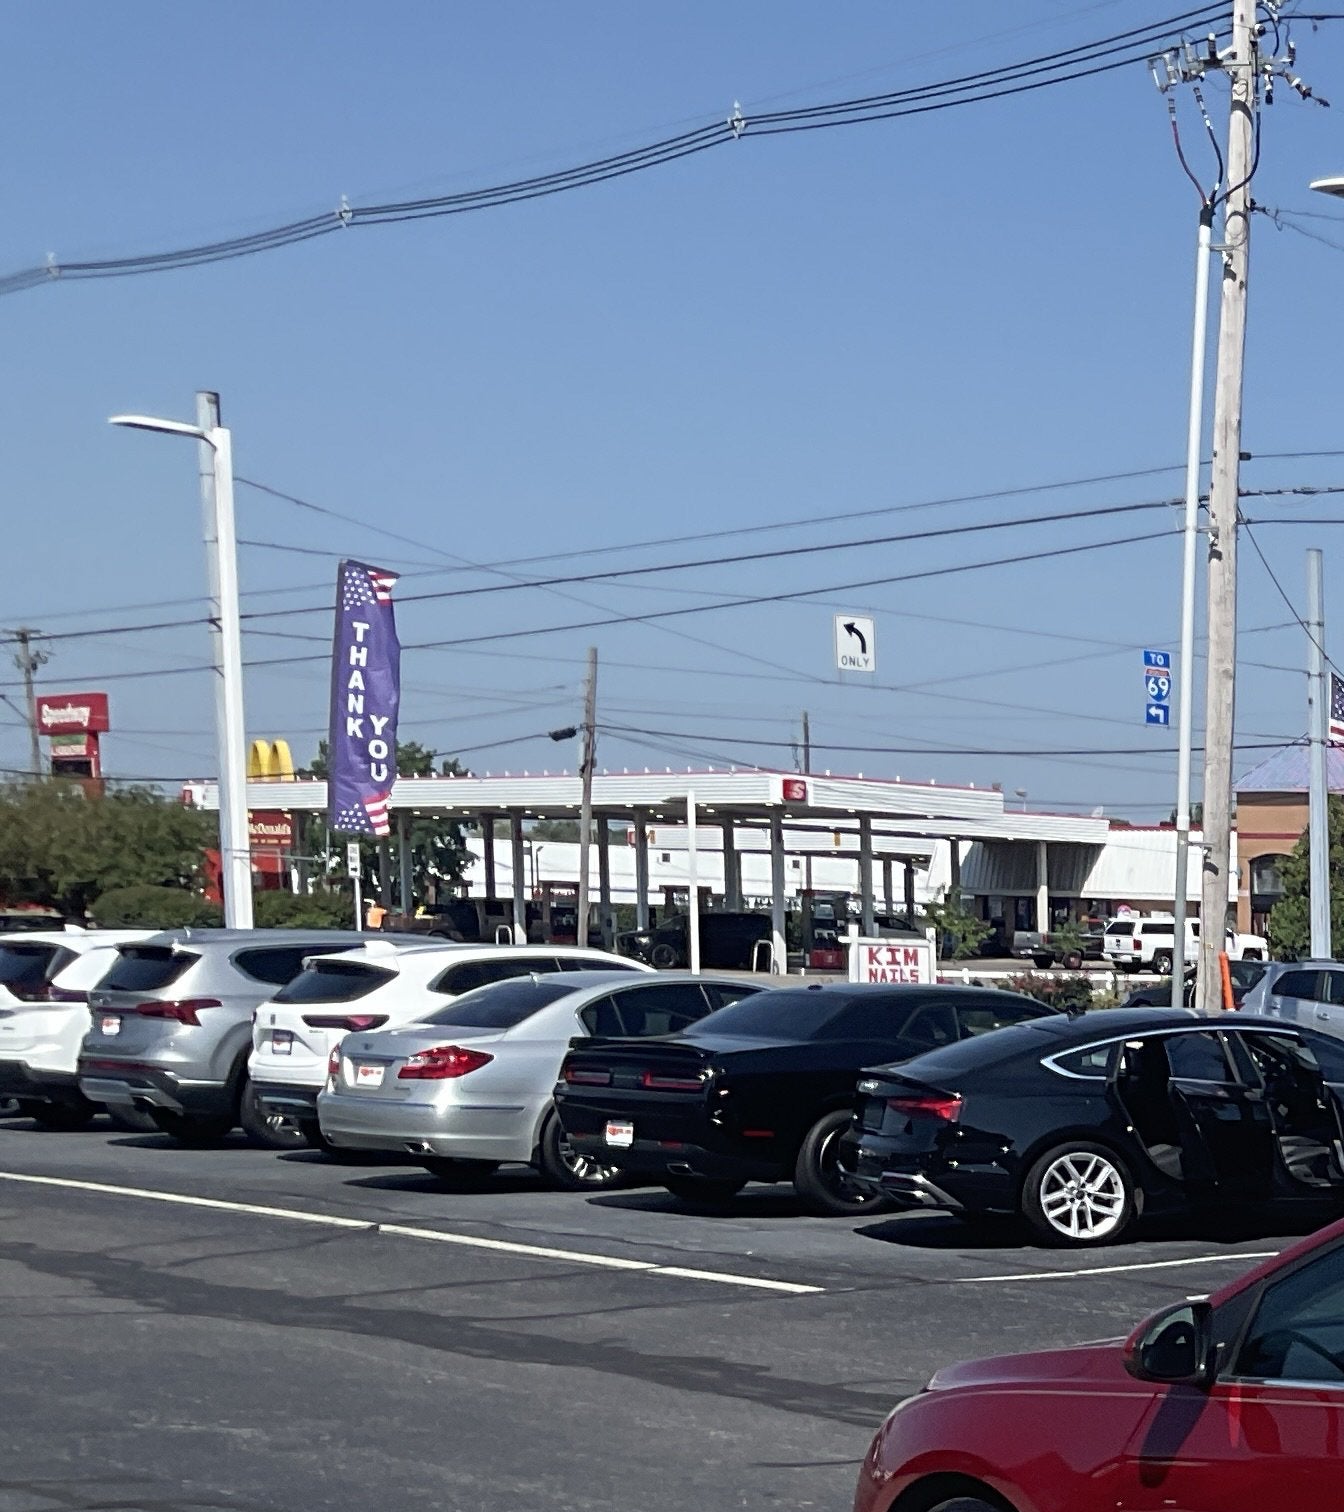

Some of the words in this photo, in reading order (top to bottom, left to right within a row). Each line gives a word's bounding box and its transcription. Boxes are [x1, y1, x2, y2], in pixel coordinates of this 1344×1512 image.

[841, 655, 870, 668] ONLY
[1150, 653, 1165, 666] TO
[346, 621, 370, 738] THANK
[1148, 677, 1169, 697] 69
[368, 714, 389, 782] YOU
[791, 783, 805, 799] S
[868, 946, 918, 966] KIM
[868, 967, 919, 984] NAILS
